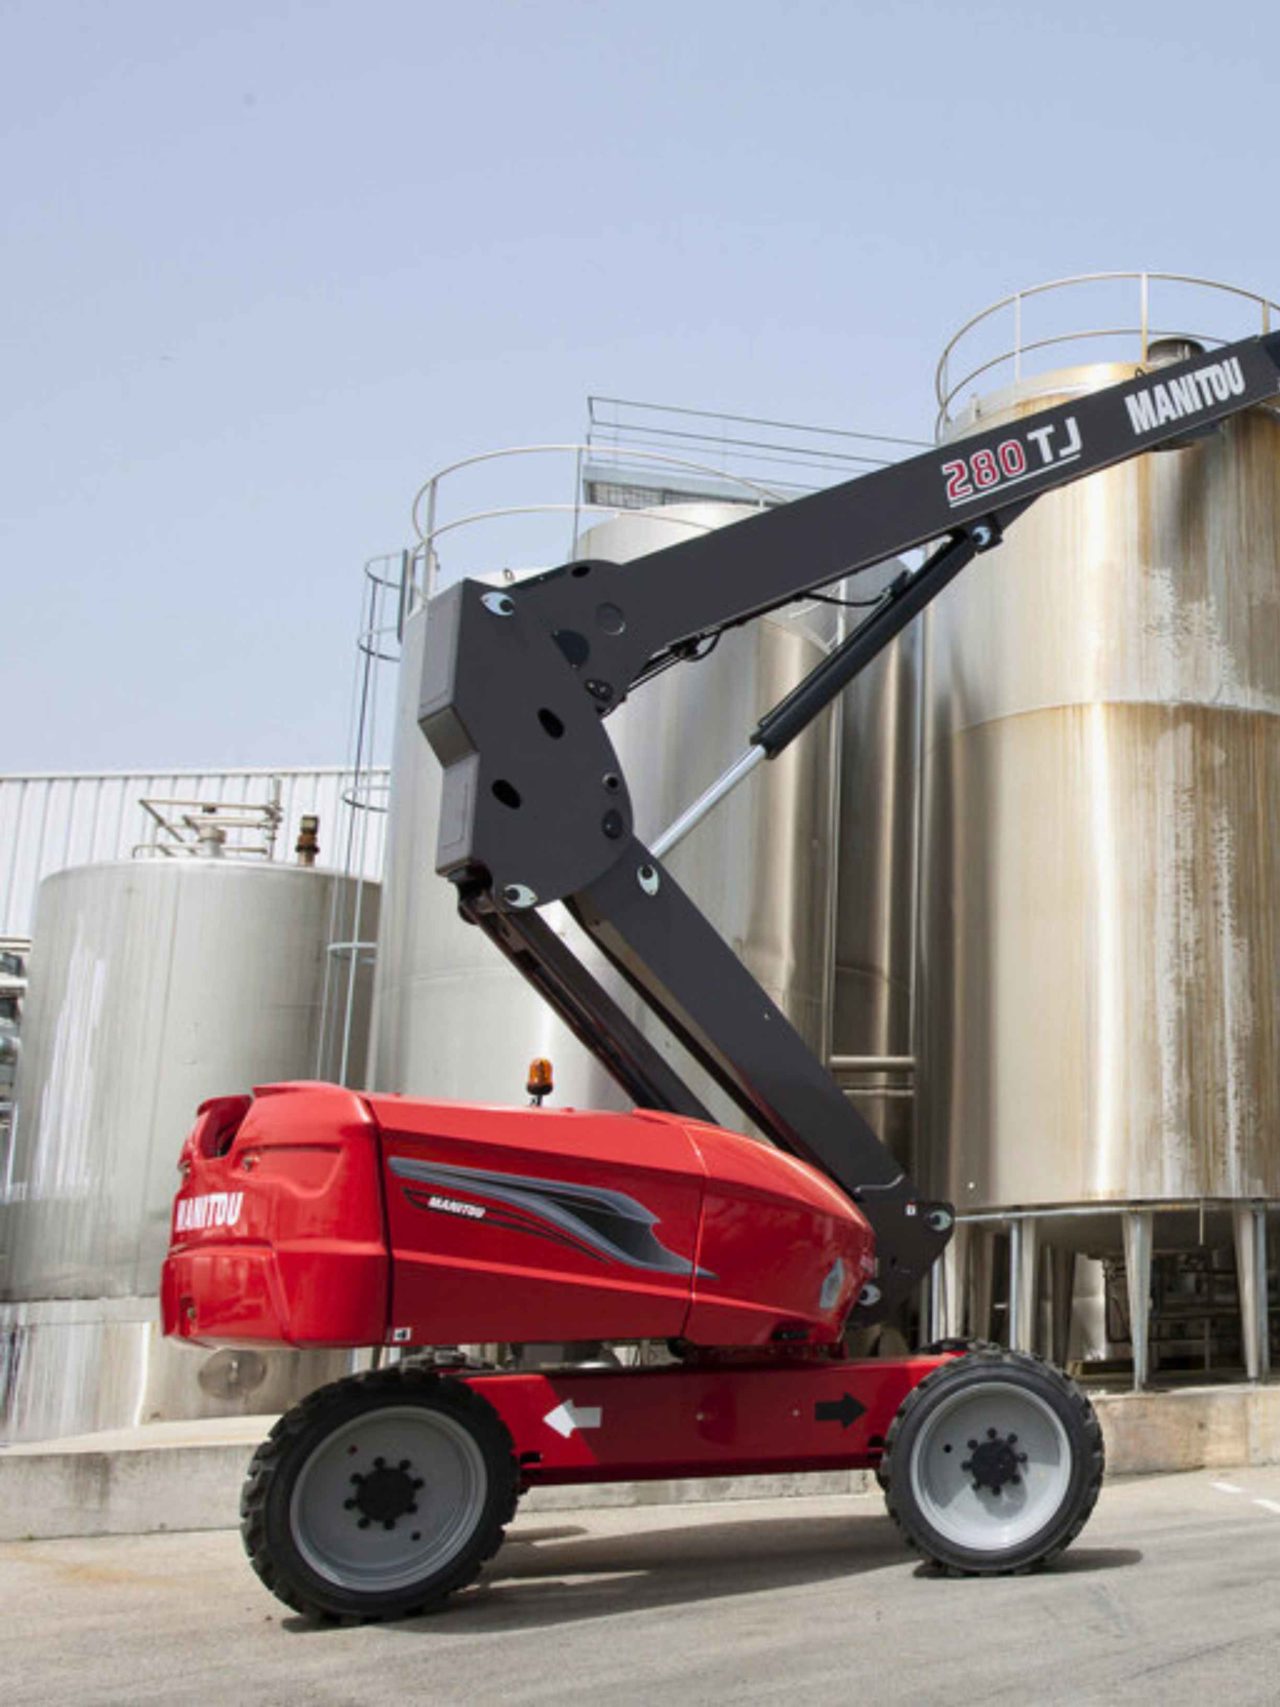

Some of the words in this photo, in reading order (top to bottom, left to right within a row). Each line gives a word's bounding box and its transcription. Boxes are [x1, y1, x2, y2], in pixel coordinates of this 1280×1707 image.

[1125, 356, 1246, 435] MANITOU
[942, 440, 1026, 501] 280
[1027, 416, 1082, 463] TJ
[174, 1192, 244, 1233] MANITOU
[427, 1196, 486, 1218] MANITOU
